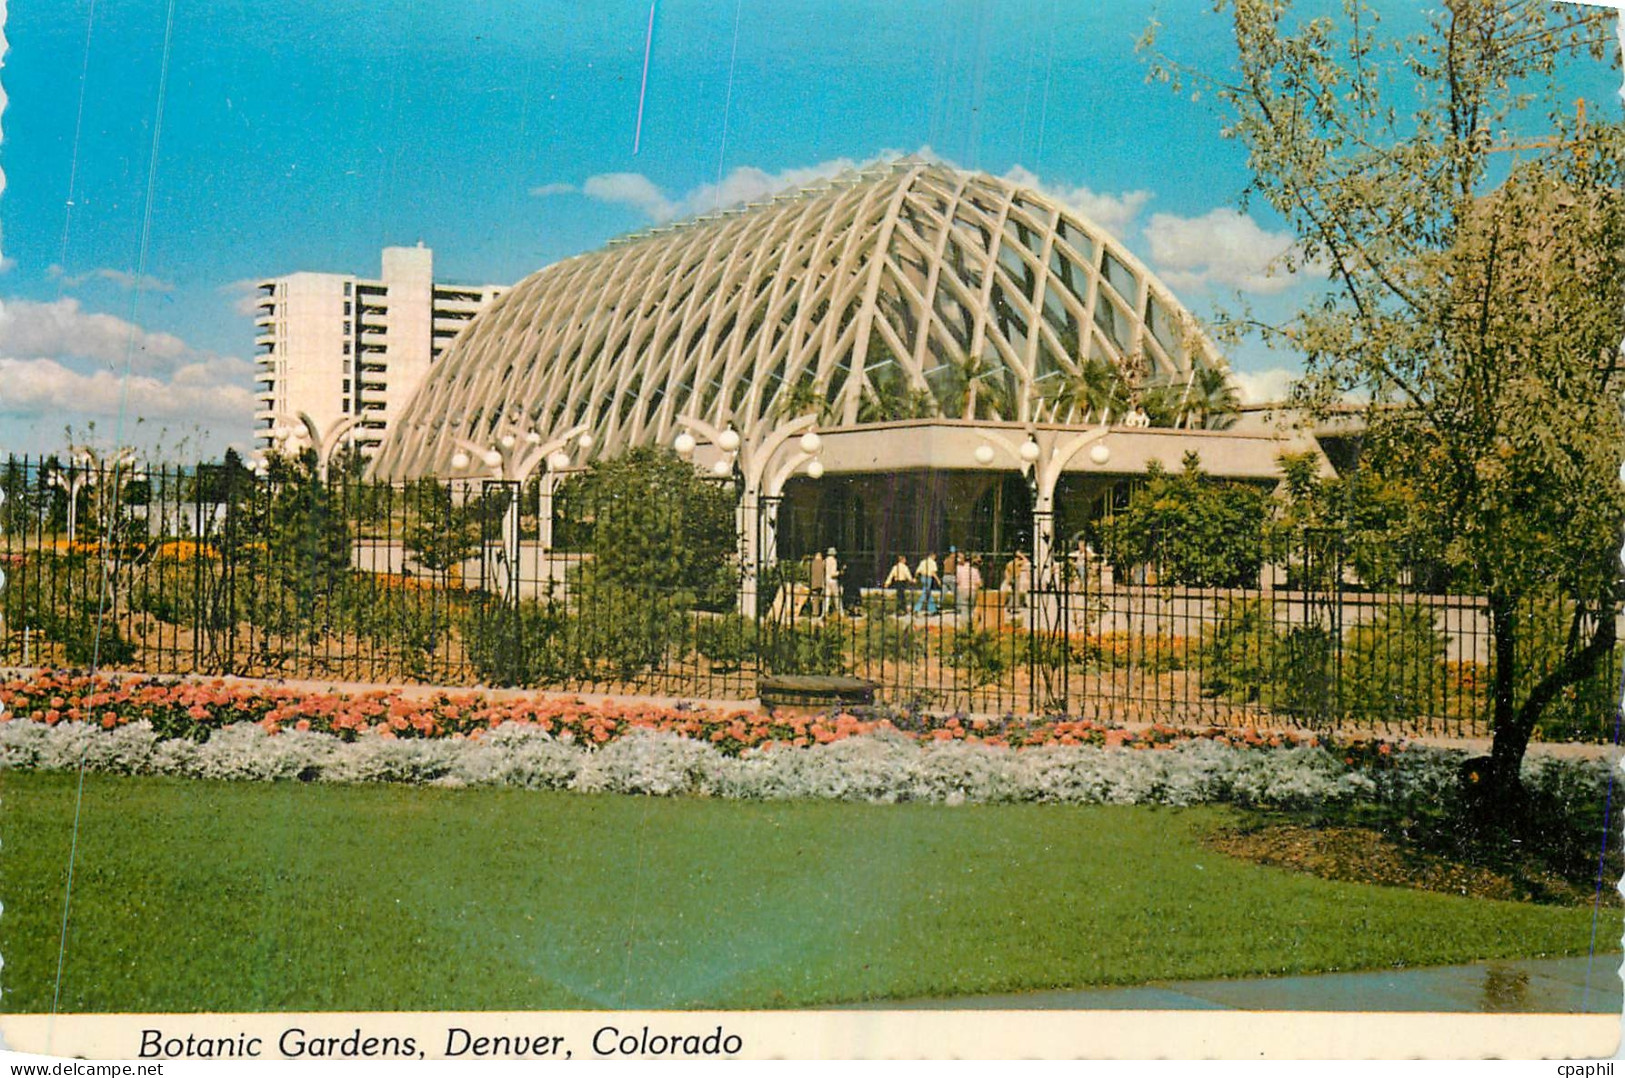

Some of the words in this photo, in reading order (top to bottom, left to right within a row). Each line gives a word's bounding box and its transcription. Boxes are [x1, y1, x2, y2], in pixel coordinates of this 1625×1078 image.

[138, 1028, 262, 1058] Botanic
[278, 1028, 425, 1060] Gardens,
[444, 1027, 572, 1060] Denver,
[592, 1025, 743, 1056] Colorado
